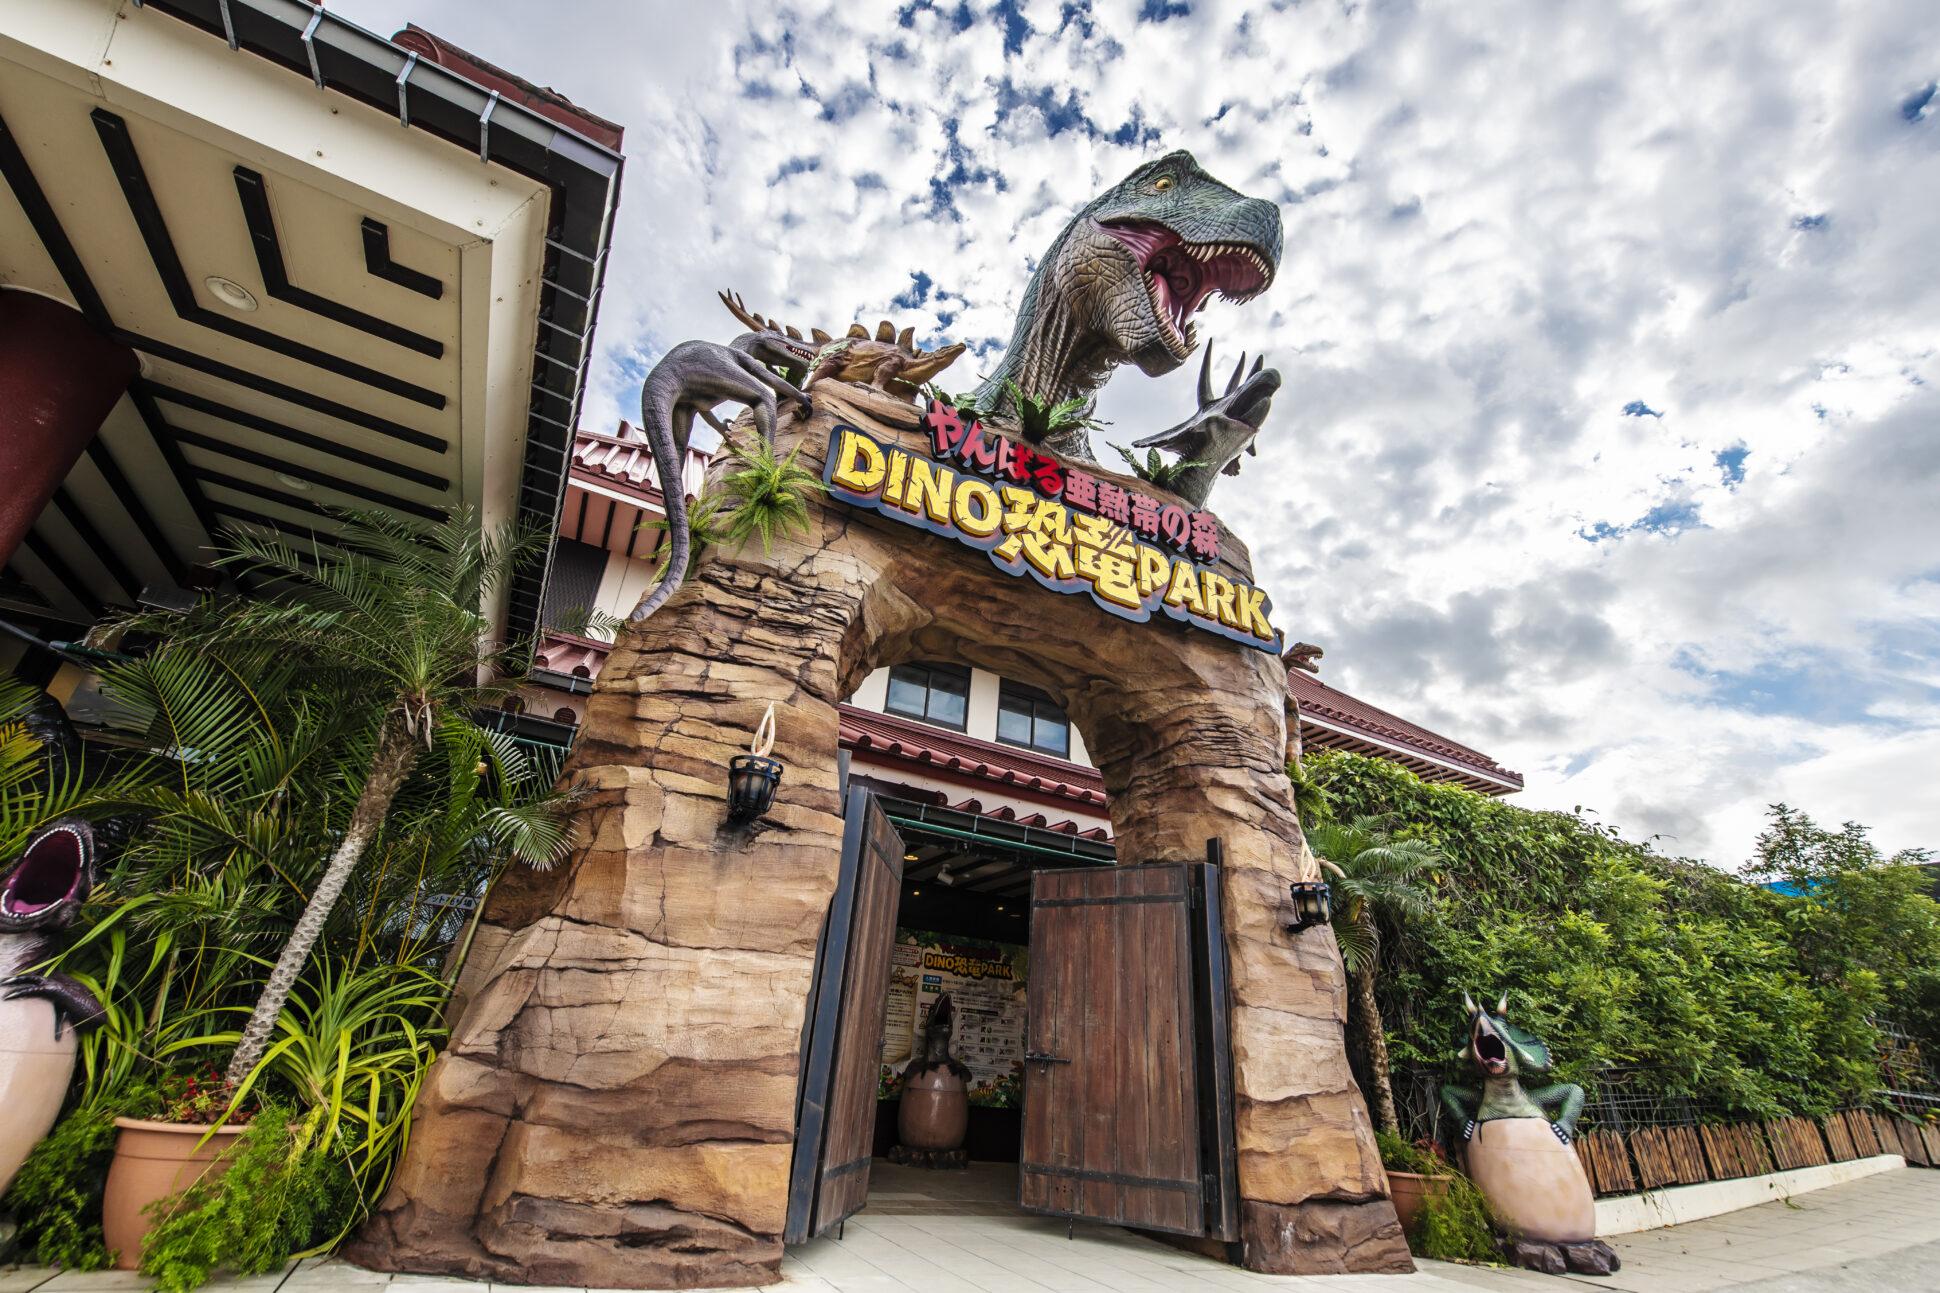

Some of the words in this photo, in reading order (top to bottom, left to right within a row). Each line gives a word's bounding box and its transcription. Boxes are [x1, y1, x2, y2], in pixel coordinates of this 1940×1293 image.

[831, 430, 1276, 642] DINO恐竜PARK
[925, 398, 1220, 561] やんばる亜熱帯の森
